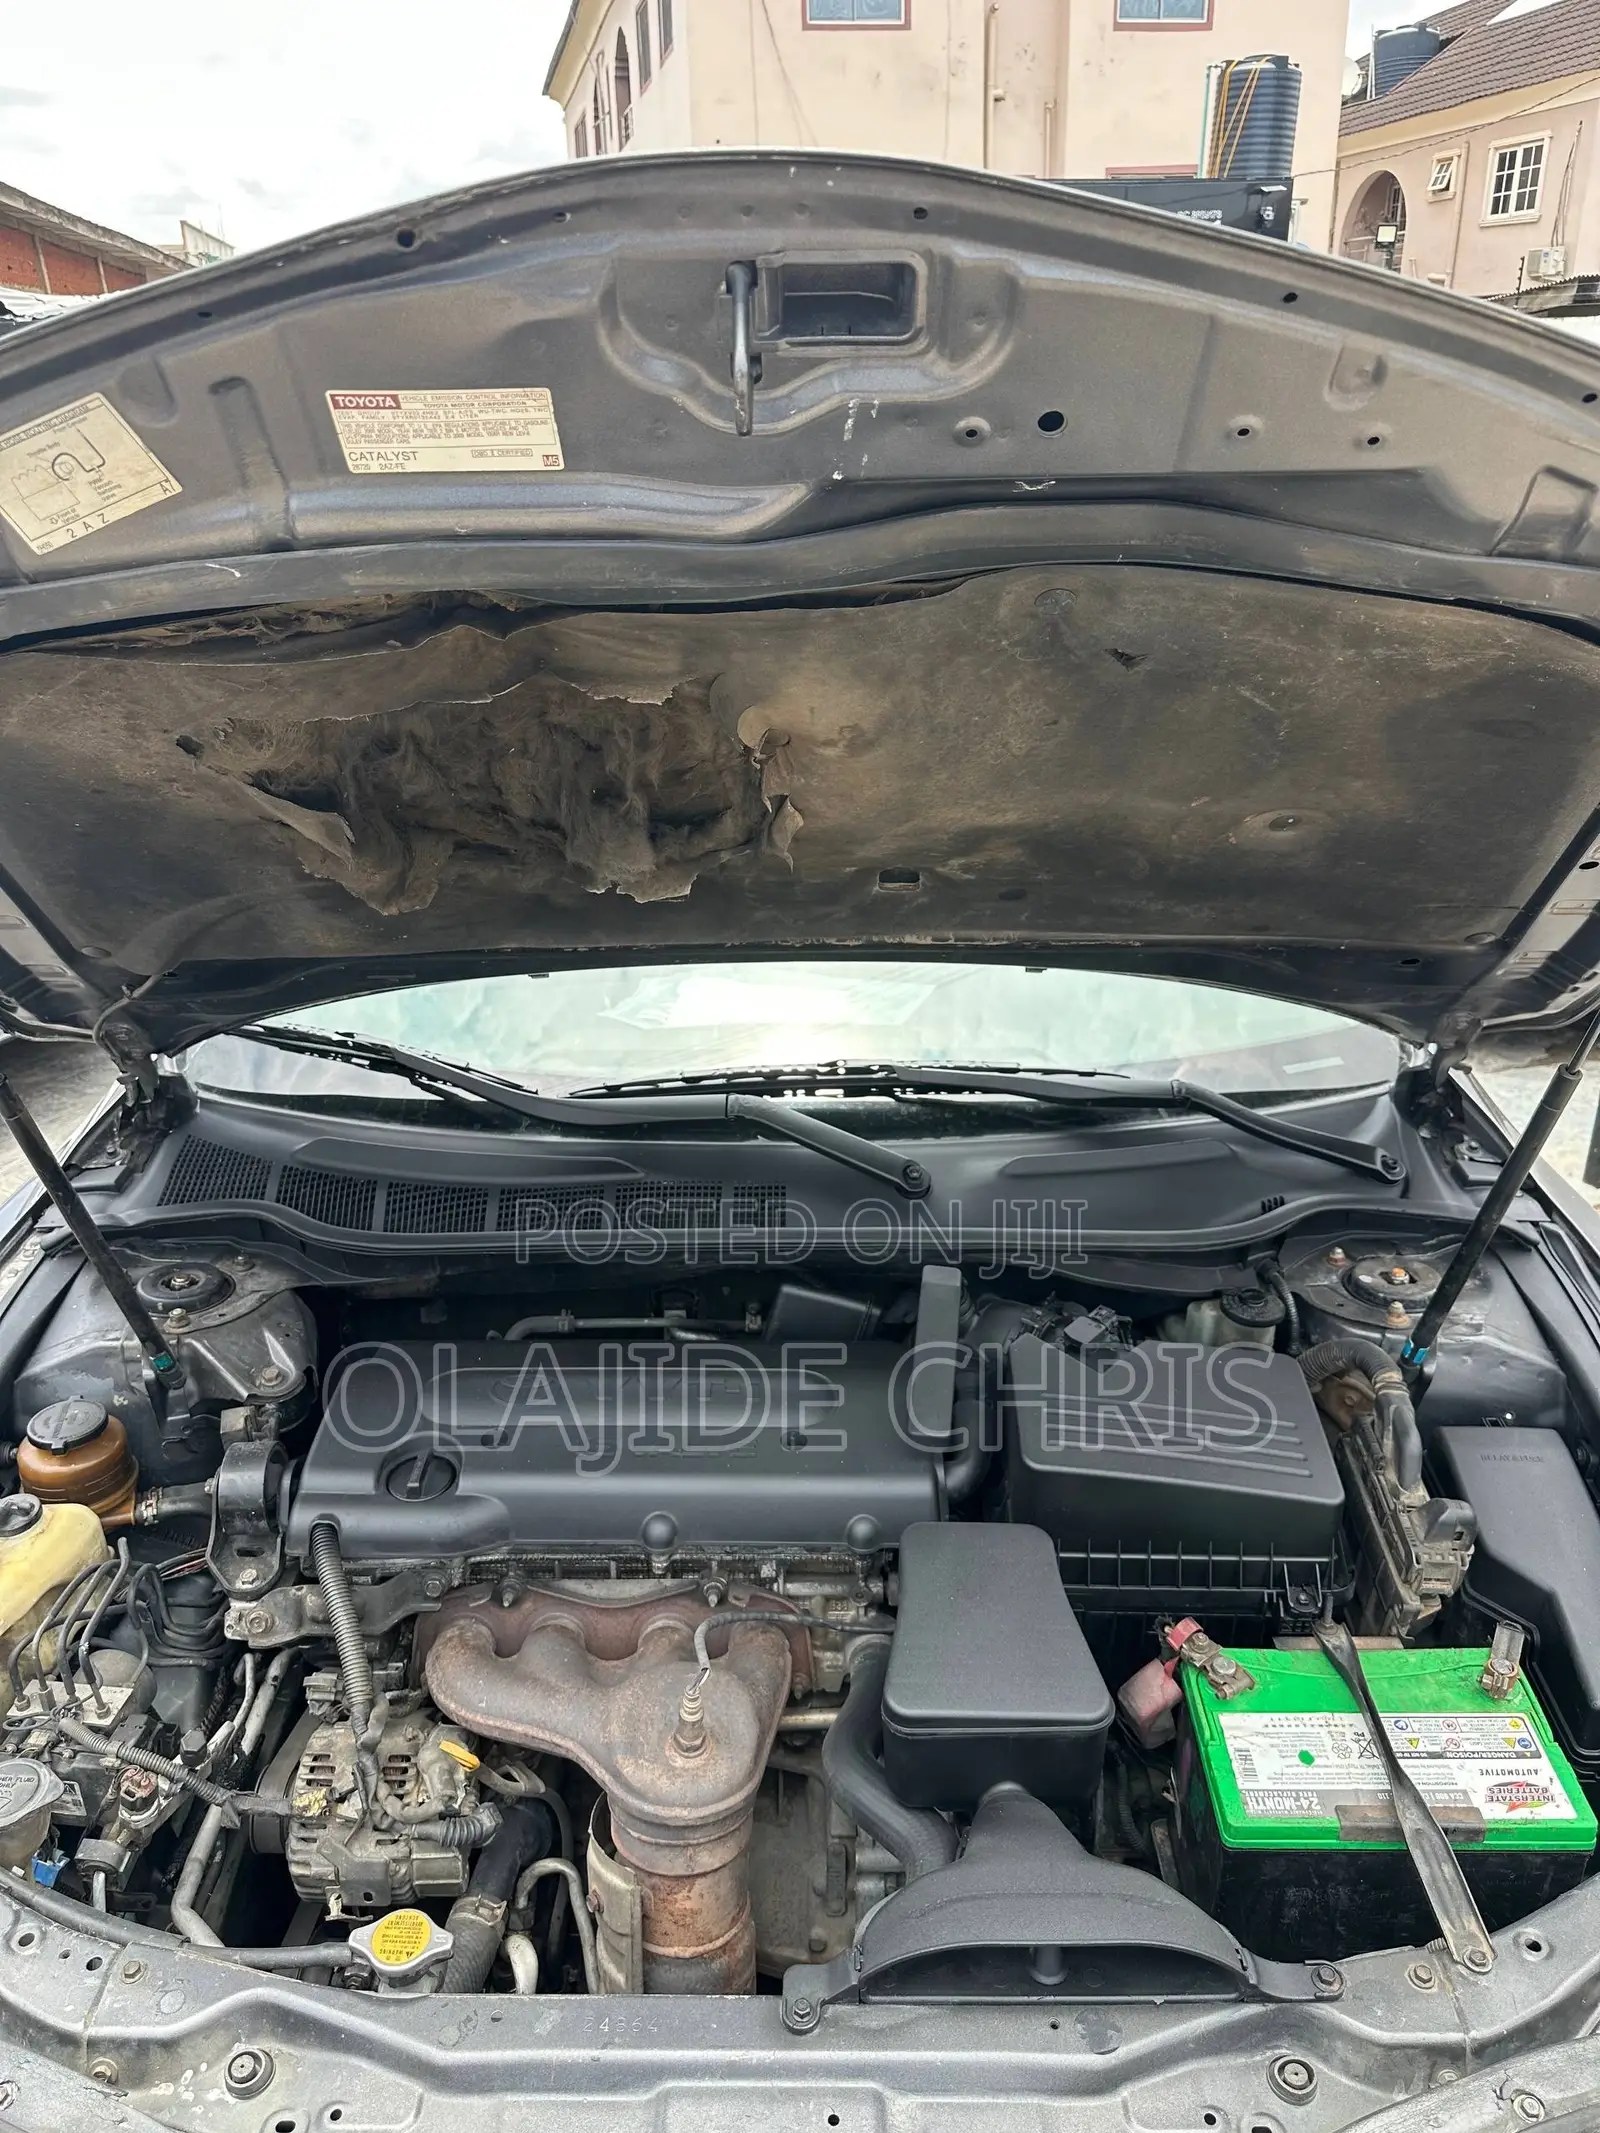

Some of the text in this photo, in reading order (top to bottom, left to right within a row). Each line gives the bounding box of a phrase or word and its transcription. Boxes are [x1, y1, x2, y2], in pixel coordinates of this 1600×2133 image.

[499, 392, 546, 400] INFORMATION
[334, 396, 396, 408] TOYOTA
[348, 451, 418, 462] CATALYST
[543, 455, 560, 466] M5
[378, 462, 406, 471] 2AZ-FE
[1446, 1750, 1517, 1760] DANGER/POISON
[1478, 1768, 1539, 1777] AUTOMOTIVE
[1377, 1792, 1390, 1800] 110
[1448, 1792, 1464, 1800] CCA
[1486, 1786, 1550, 1796] BATTERIES
[1246, 1796, 1322, 1811] 24-MONTH
[1485, 1794, 1556, 1804] INTERSTATE
